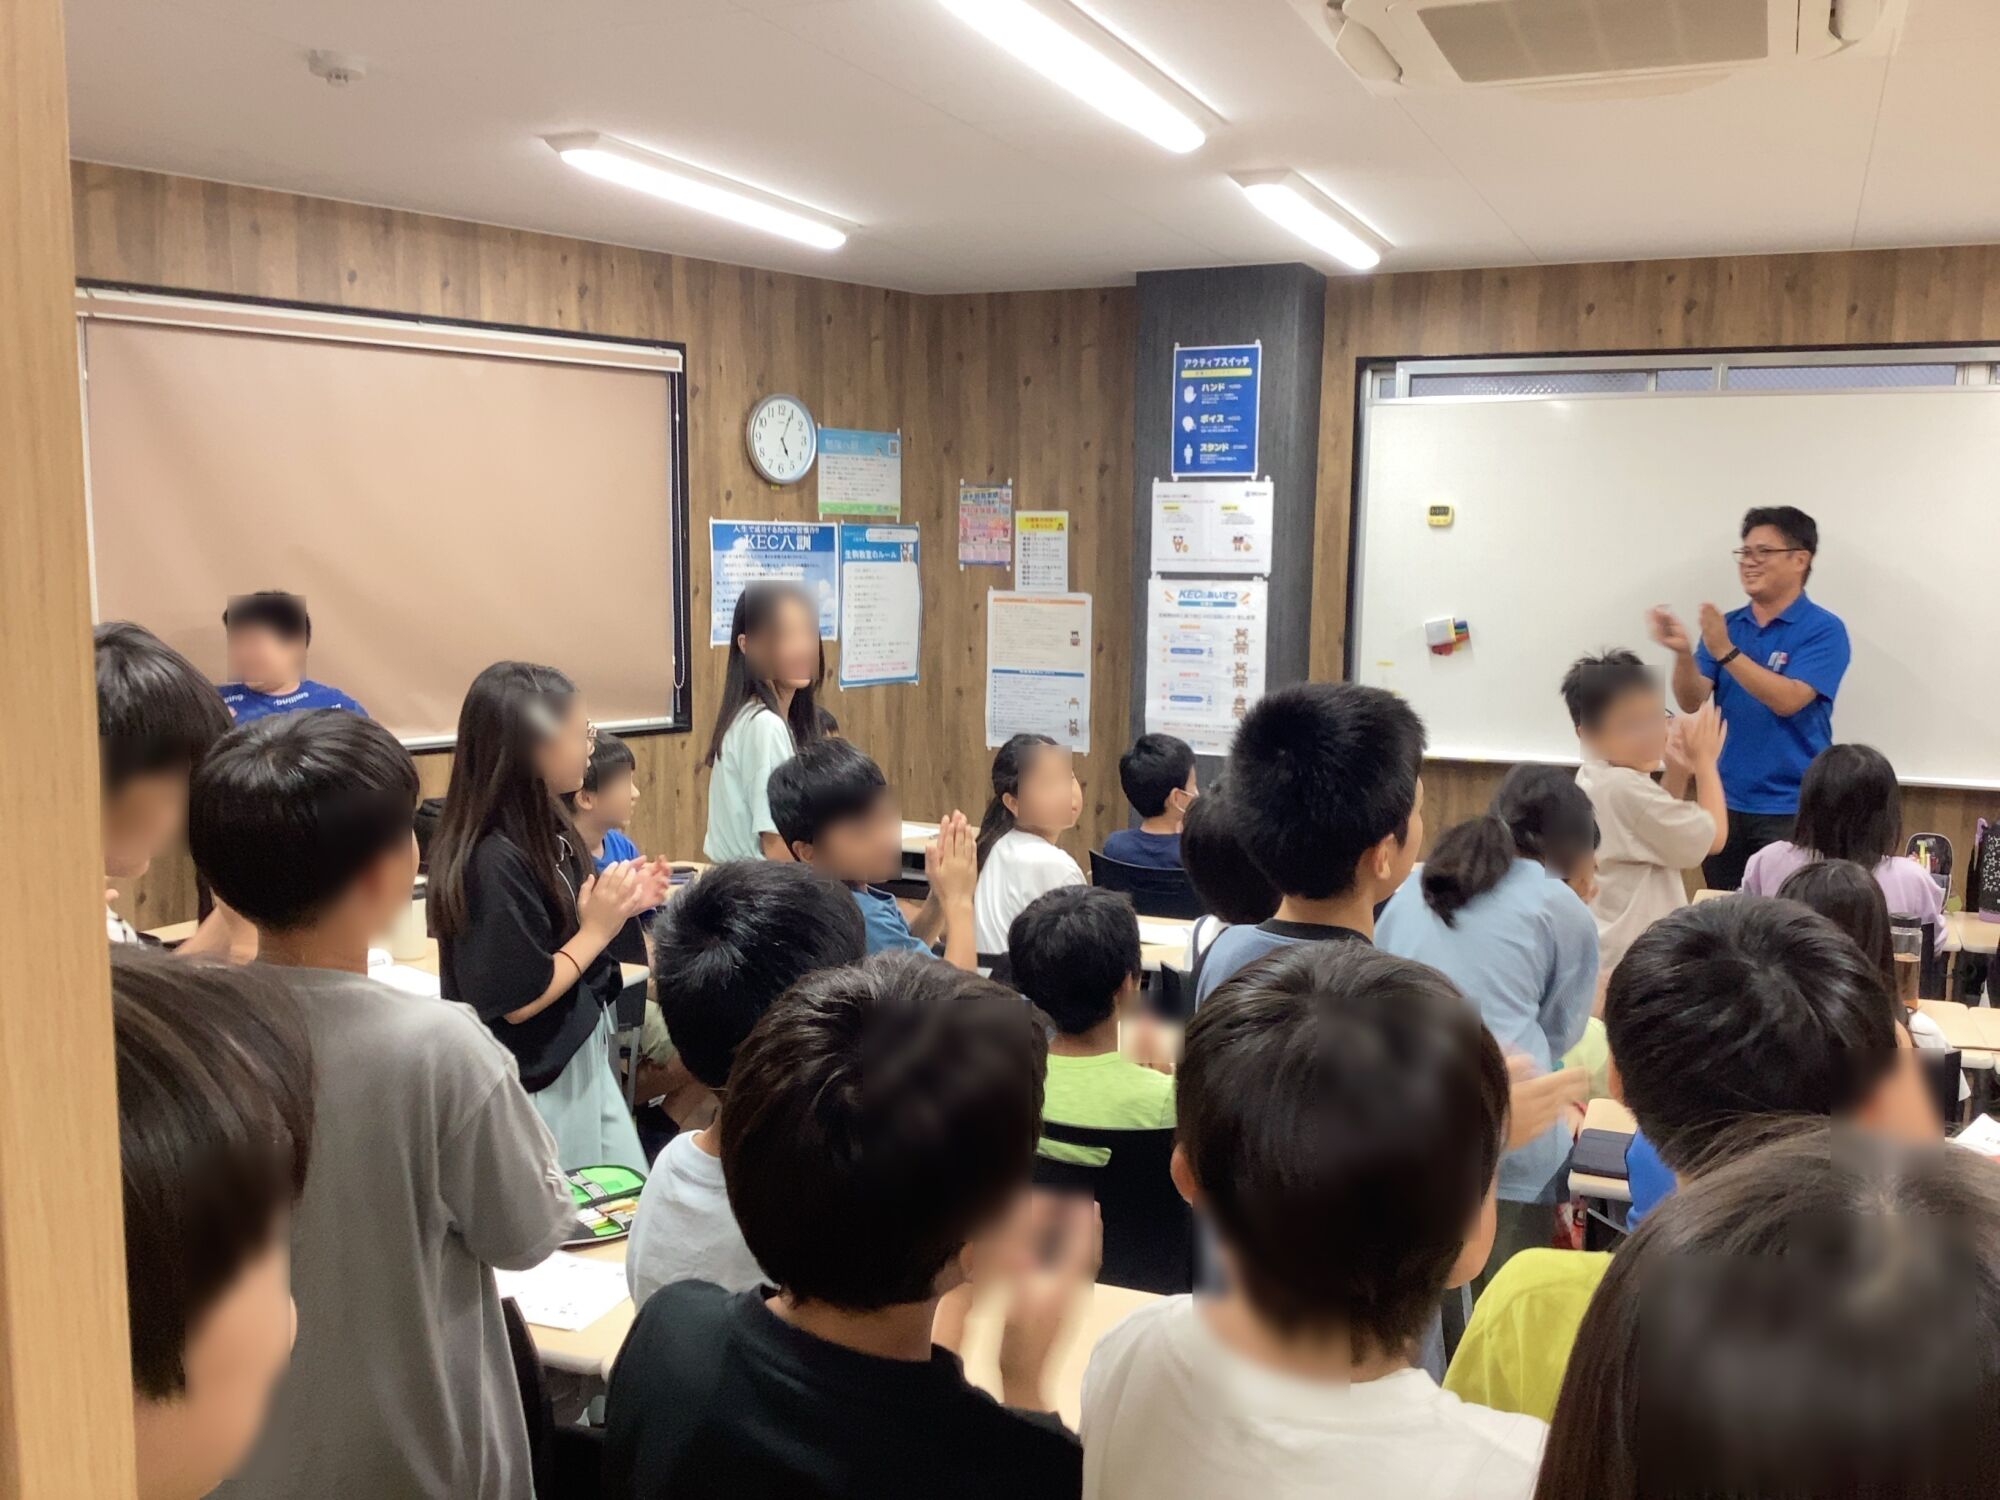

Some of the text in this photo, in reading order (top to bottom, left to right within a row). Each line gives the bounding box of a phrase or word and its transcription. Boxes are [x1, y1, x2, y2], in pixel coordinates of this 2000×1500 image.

[1201, 383, 1226, 393] ハンド
[767, 406, 775, 418] 11
[777, 404, 786, 417] 12
[797, 420, 804, 432] 2
[755, 431, 762, 443] 9
[744, 534, 811, 551] KEC八訓
